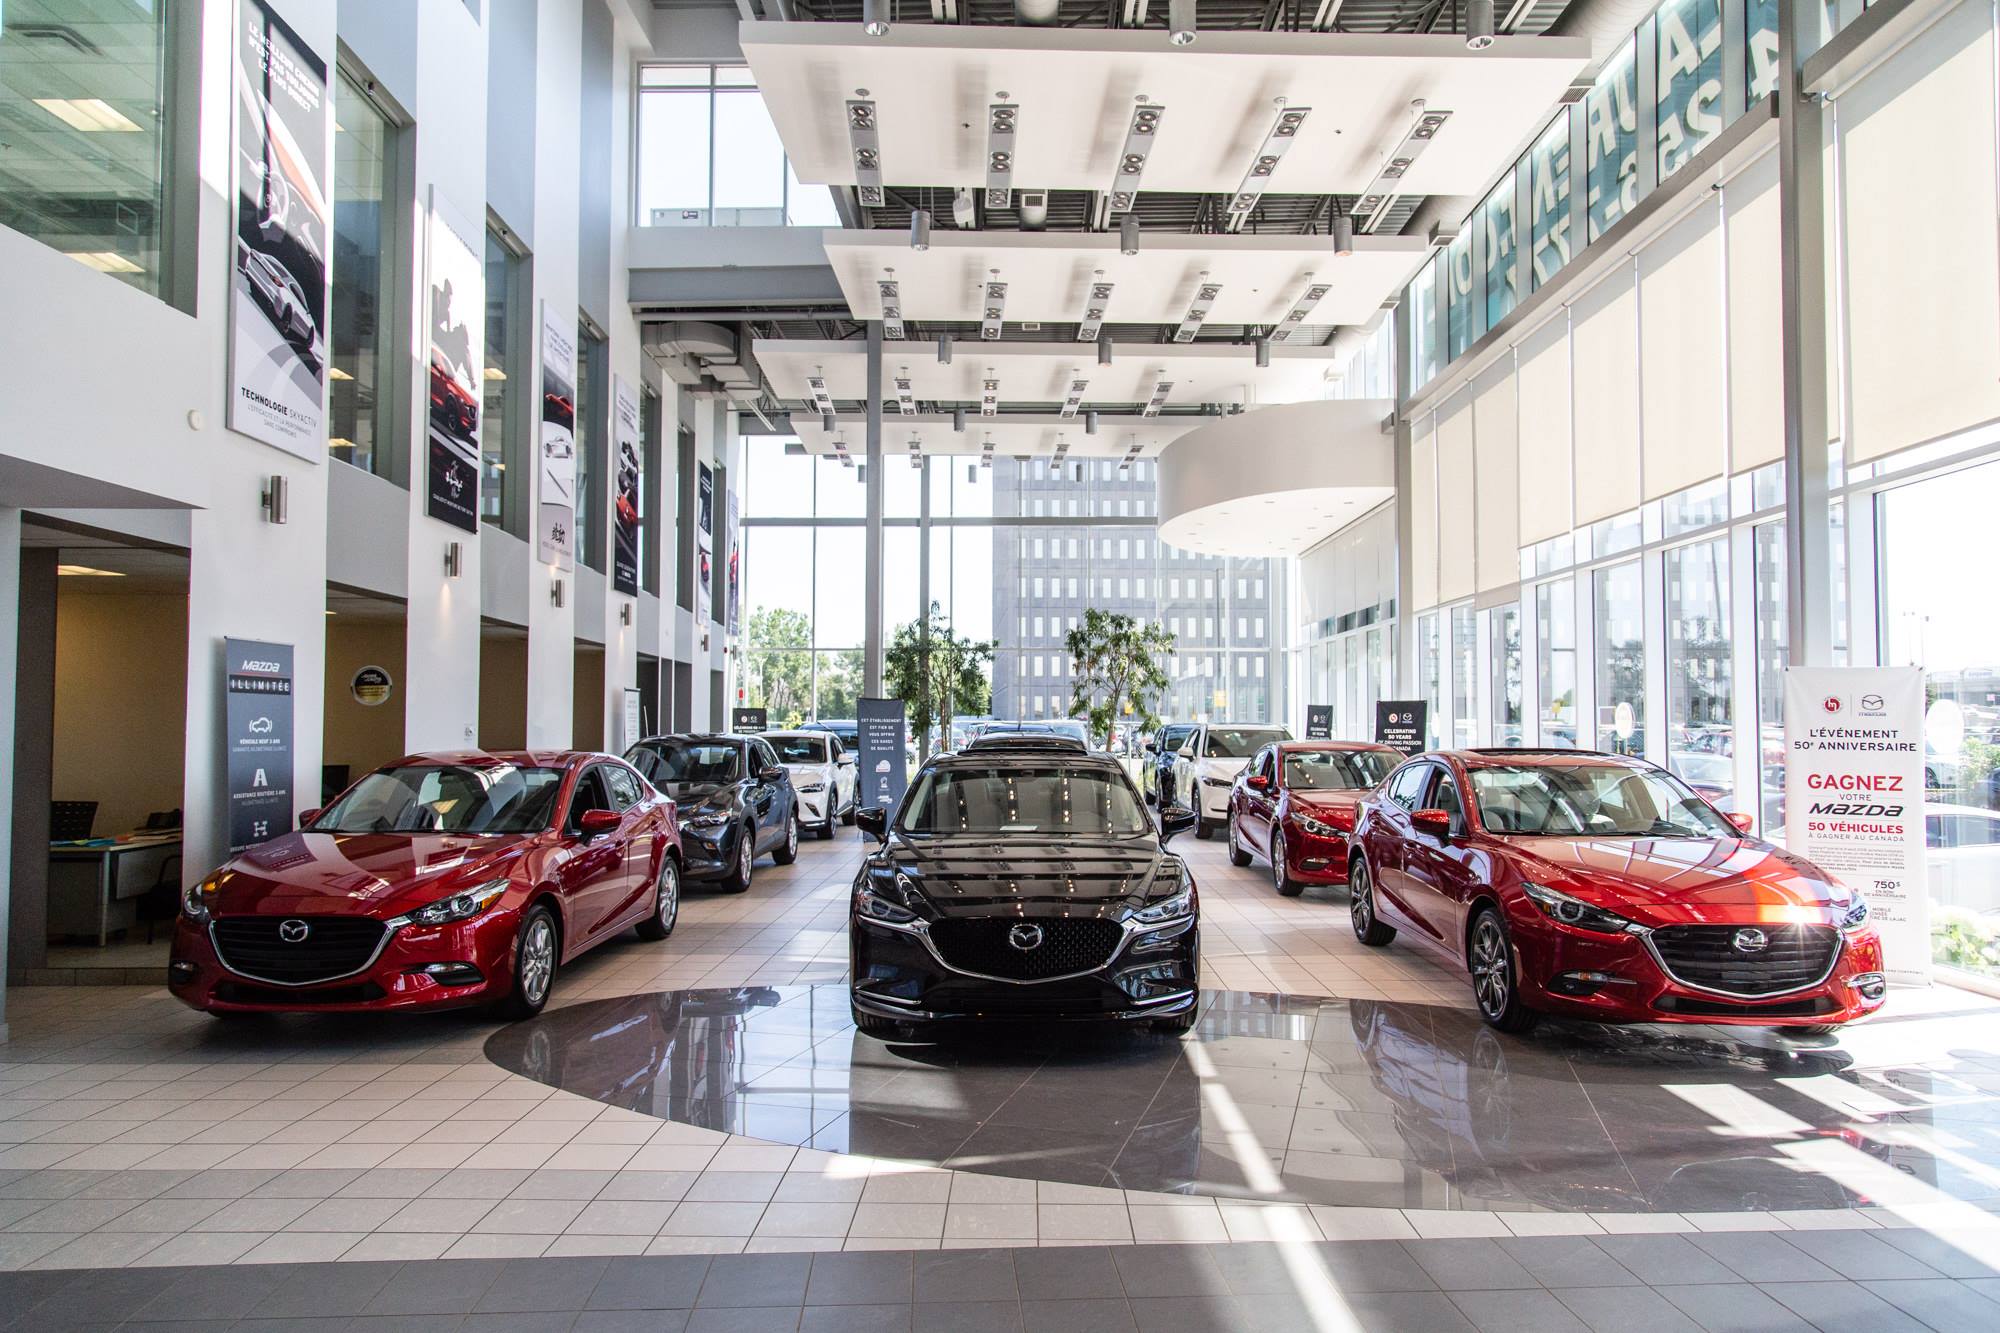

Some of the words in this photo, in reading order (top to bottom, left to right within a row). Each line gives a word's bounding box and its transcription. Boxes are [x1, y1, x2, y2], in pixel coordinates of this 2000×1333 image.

[241, 386, 288, 416] TECHNOLOGIE
[289, 408, 317, 428] SKYACTIV
[231, 679, 290, 692] ILLIMITÉE
[1809, 727, 1898, 738] L'ÉVÉNEMENT
[1818, 741, 1917, 752] ANNIVERSAIRE
[1807, 773, 1904, 791] GAGNEZ
[1839, 793, 1872, 801] VOTRE
[1808, 822, 1826, 831] 50
[1830, 821, 1904, 834] VÉHICULES
[1808, 831, 1814, 839] À
[1869, 834, 1905, 842] CANADA
